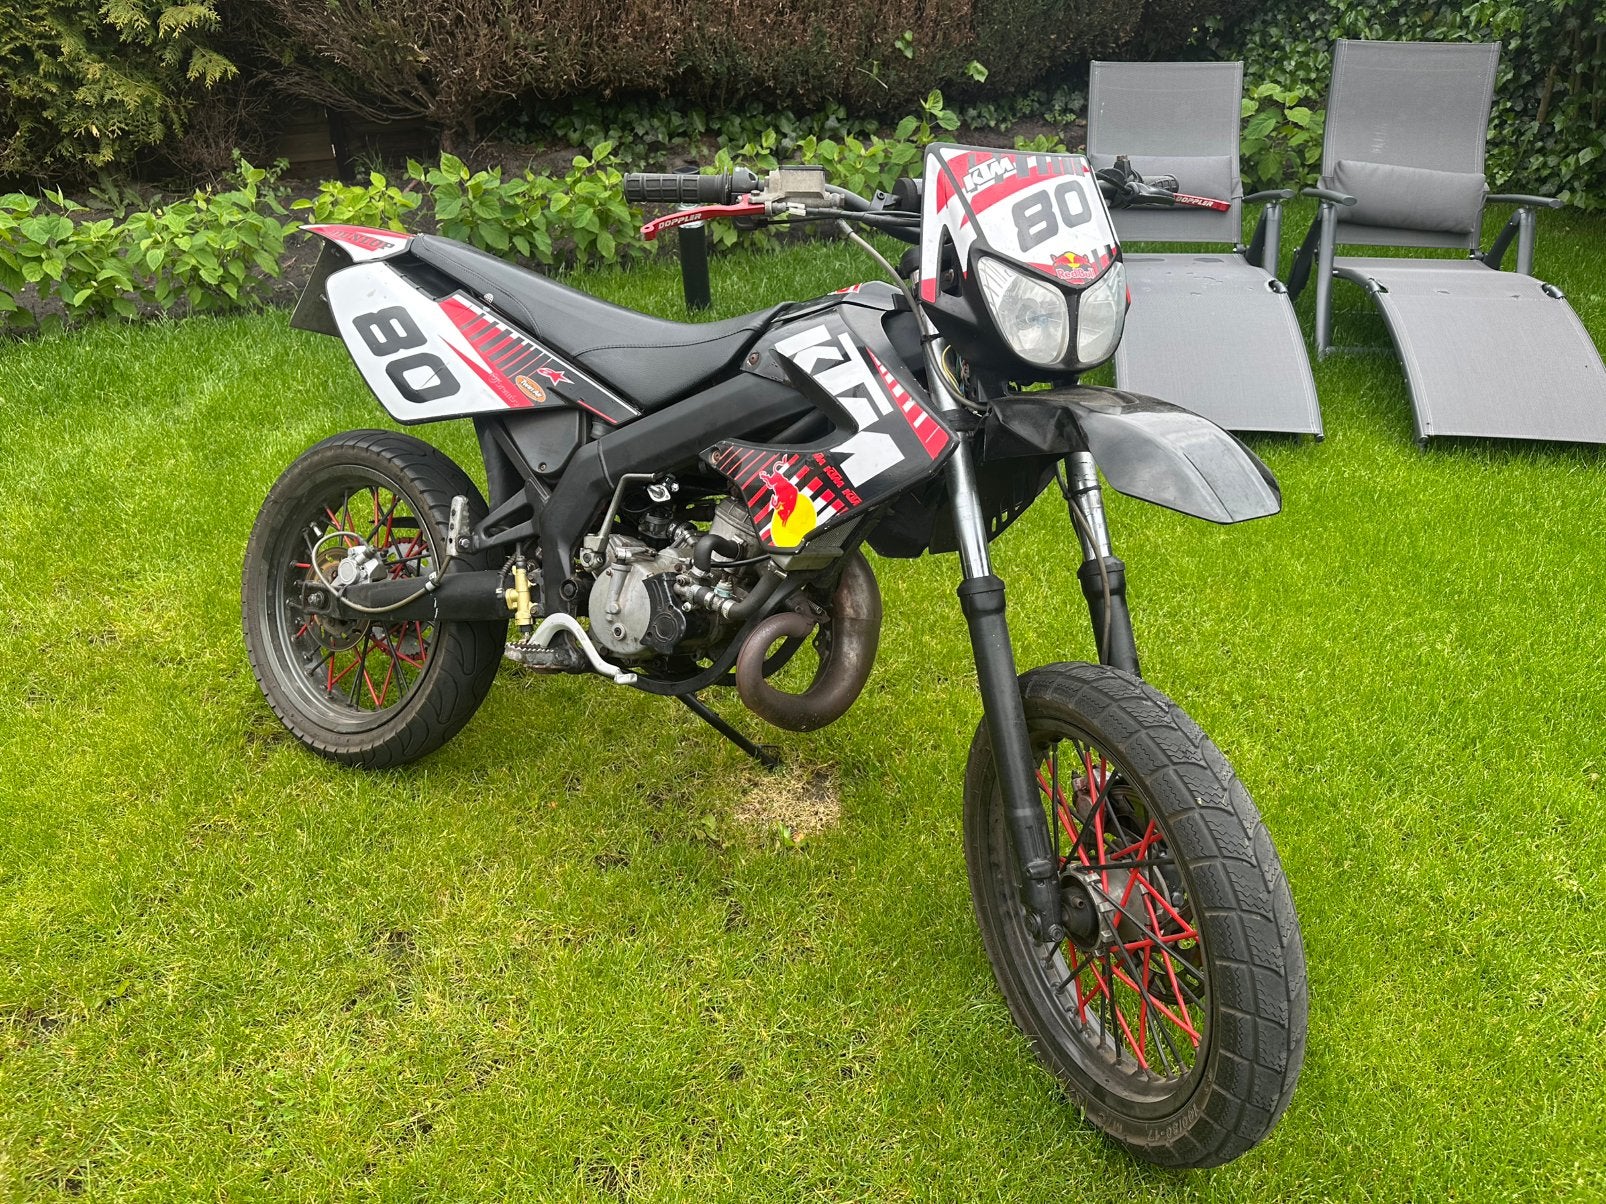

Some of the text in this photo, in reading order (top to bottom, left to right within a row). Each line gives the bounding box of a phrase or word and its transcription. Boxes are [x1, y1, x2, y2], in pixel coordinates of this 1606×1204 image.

[962, 155, 1016, 193] KTM
[1175, 196, 1213, 207] DOPPLER
[657, 213, 702, 230] DOPPLER
[1011, 180, 1092, 253] 80
[331, 230, 395, 249] DUNLOP
[1055, 267, 1096, 280] Red Bull
[352, 305, 461, 404] 80
[774, 324, 905, 488] KTM
[823, 465, 845, 488] KTM
